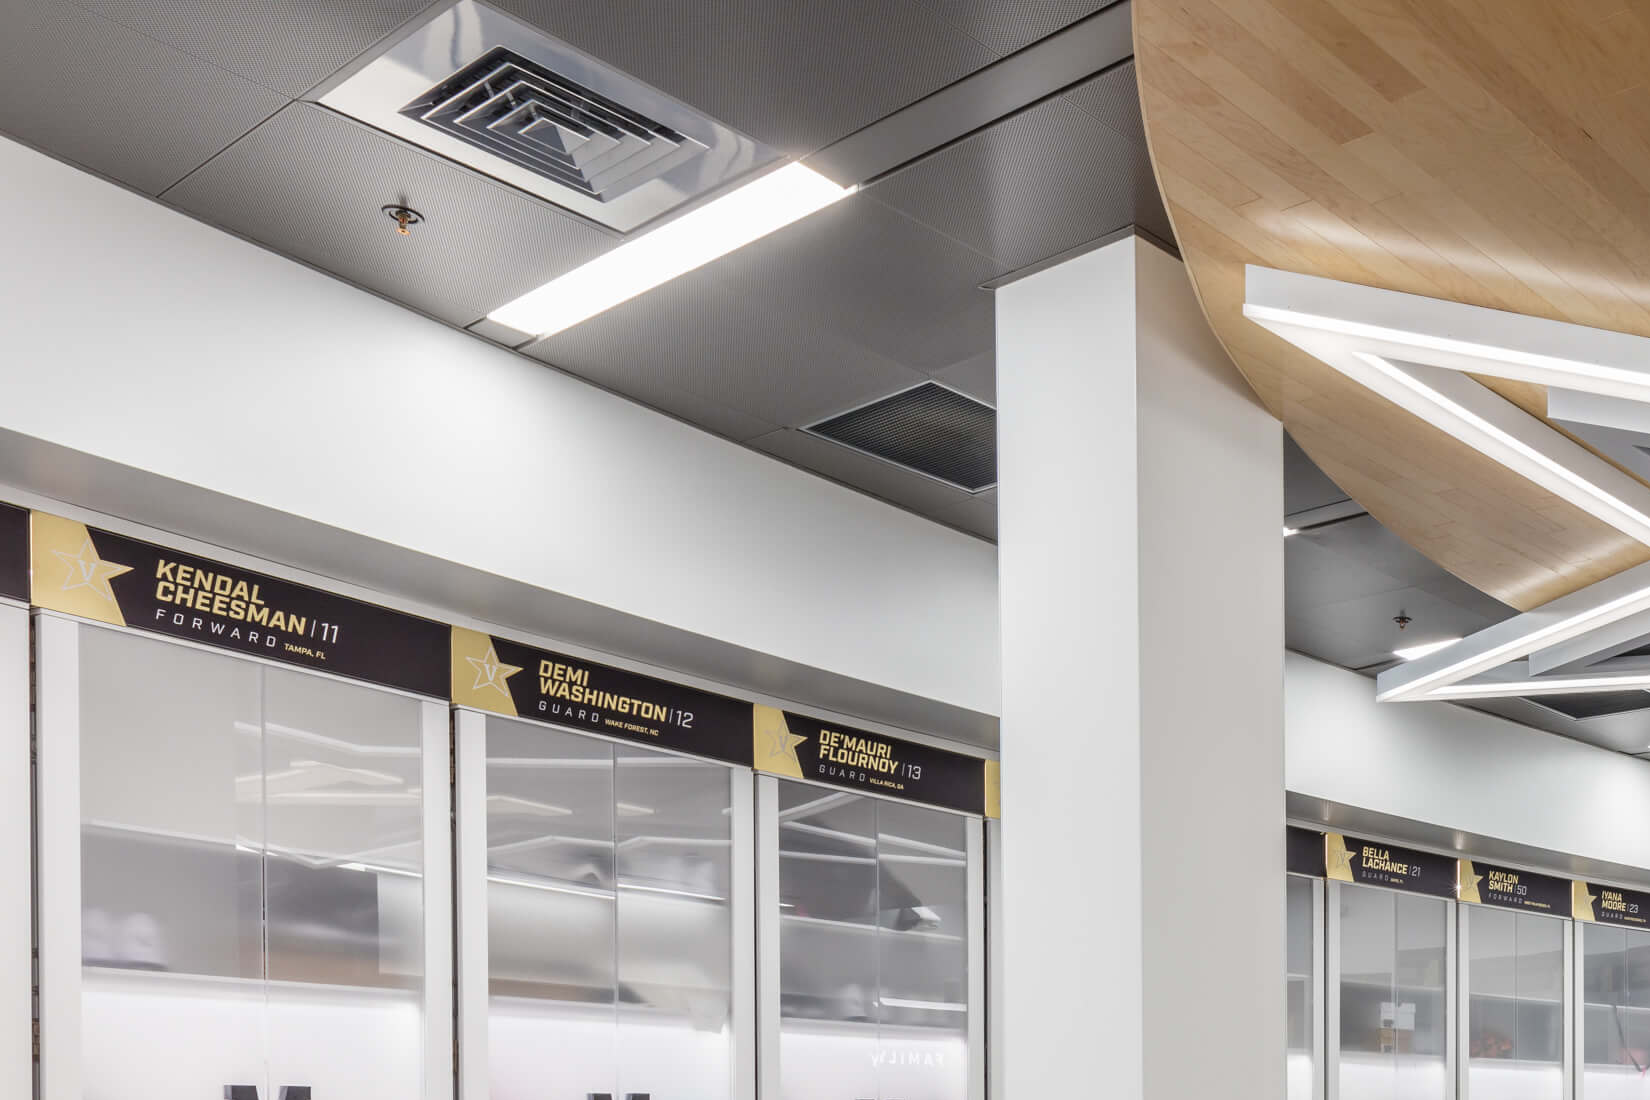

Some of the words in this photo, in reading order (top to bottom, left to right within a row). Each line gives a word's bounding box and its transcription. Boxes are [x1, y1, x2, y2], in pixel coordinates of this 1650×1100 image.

[156, 559, 264, 605] KENDAL
[156, 581, 306, 635] CHEESMAN
[321, 623, 339, 643] 11
[156, 609, 276, 647] FORWARD
[284, 643, 314, 658] TAMPA,
[315, 651, 326, 660] FL
[539, 660, 589, 686] DEMI
[538, 701, 599, 723] GUARD
[605, 719, 623, 729] WAKE
[540, 677, 667, 722] WASHINGTON
[677, 710, 694, 728] 12
[819, 729, 891, 759] DE'MAURI
[819, 745, 899, 774] FLOURNOY
[908, 765, 921, 780] 13
[819, 765, 866, 782] GUARD
[1362, 846, 1389, 860] BELLA
[1362, 857, 1408, 874] LACHANCE
[1411, 866, 1421, 877] 21
[1489, 871, 1519, 884] KAYLON
[1489, 881, 1513, 893] SMITH
[1517, 885, 1527, 895] 50
[1602, 890, 1622, 902] IYANA
[1602, 900, 1626, 912] MOORE
[1629, 904, 1638, 913] 23
